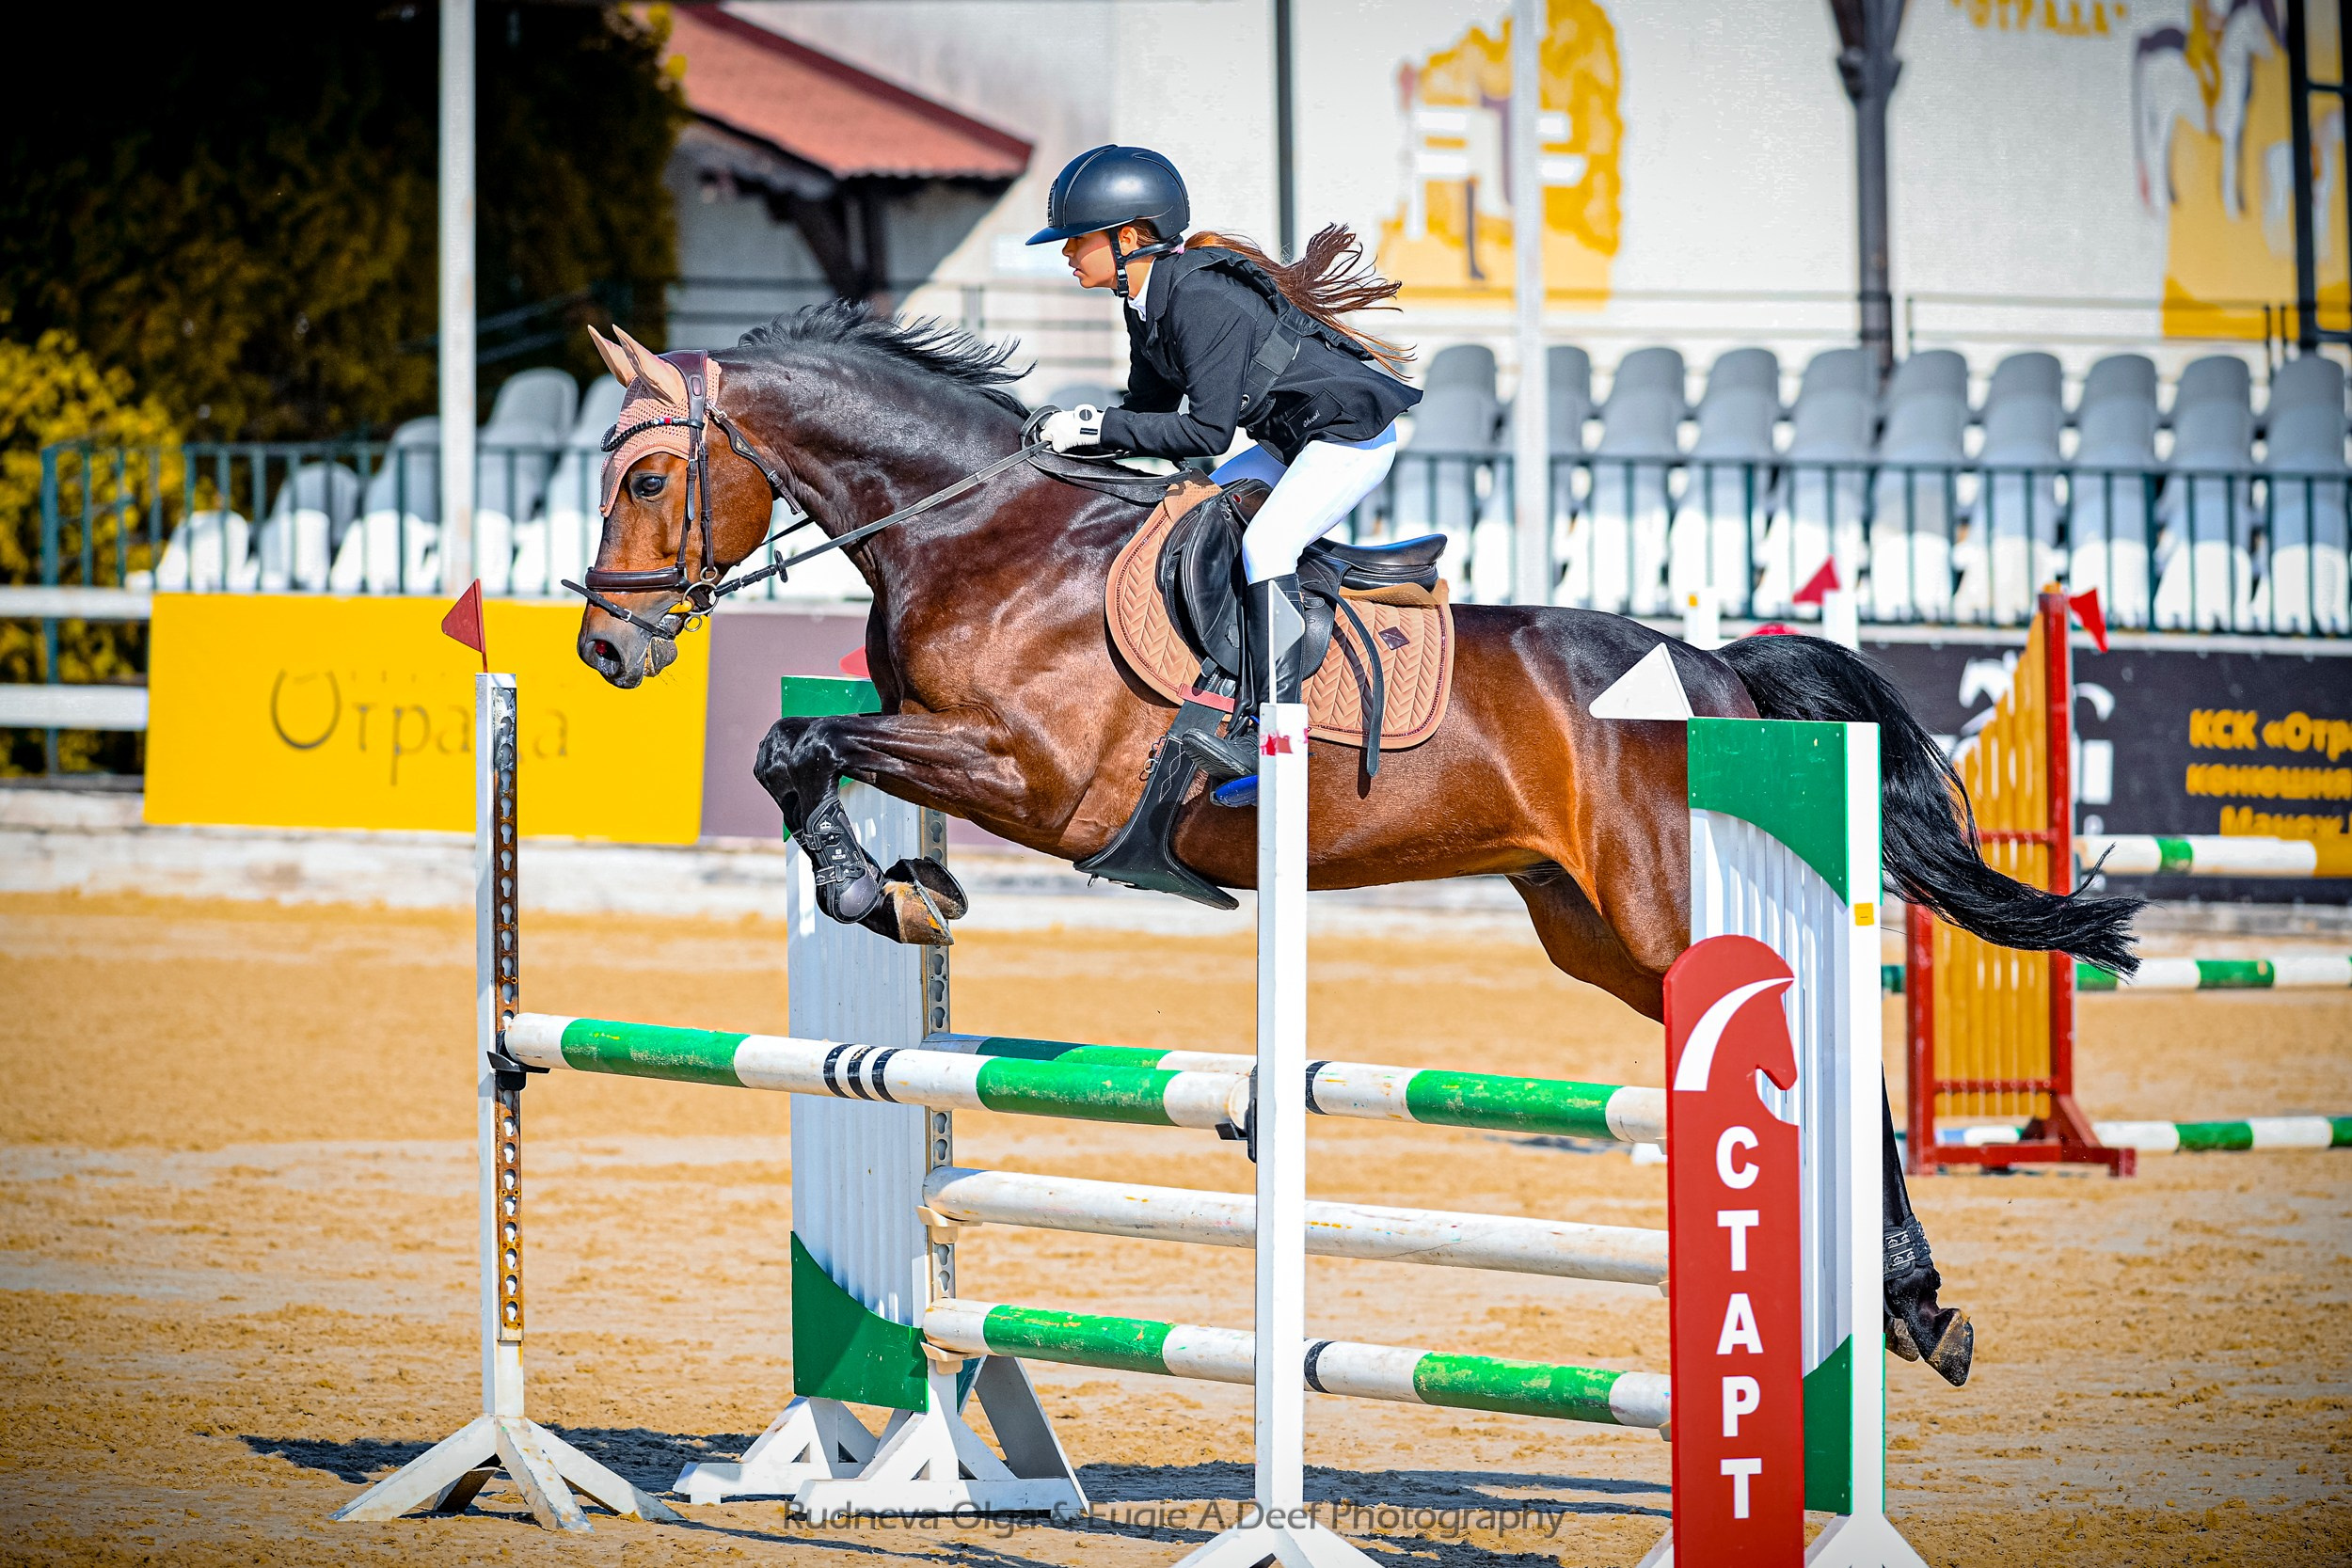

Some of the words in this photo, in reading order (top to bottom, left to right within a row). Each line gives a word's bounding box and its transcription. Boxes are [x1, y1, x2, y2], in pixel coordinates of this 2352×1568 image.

[270, 669, 569, 786] Отраа
[2188, 708, 2258, 750] КСК
[1715, 1125, 1764, 1520] СТАРТ
